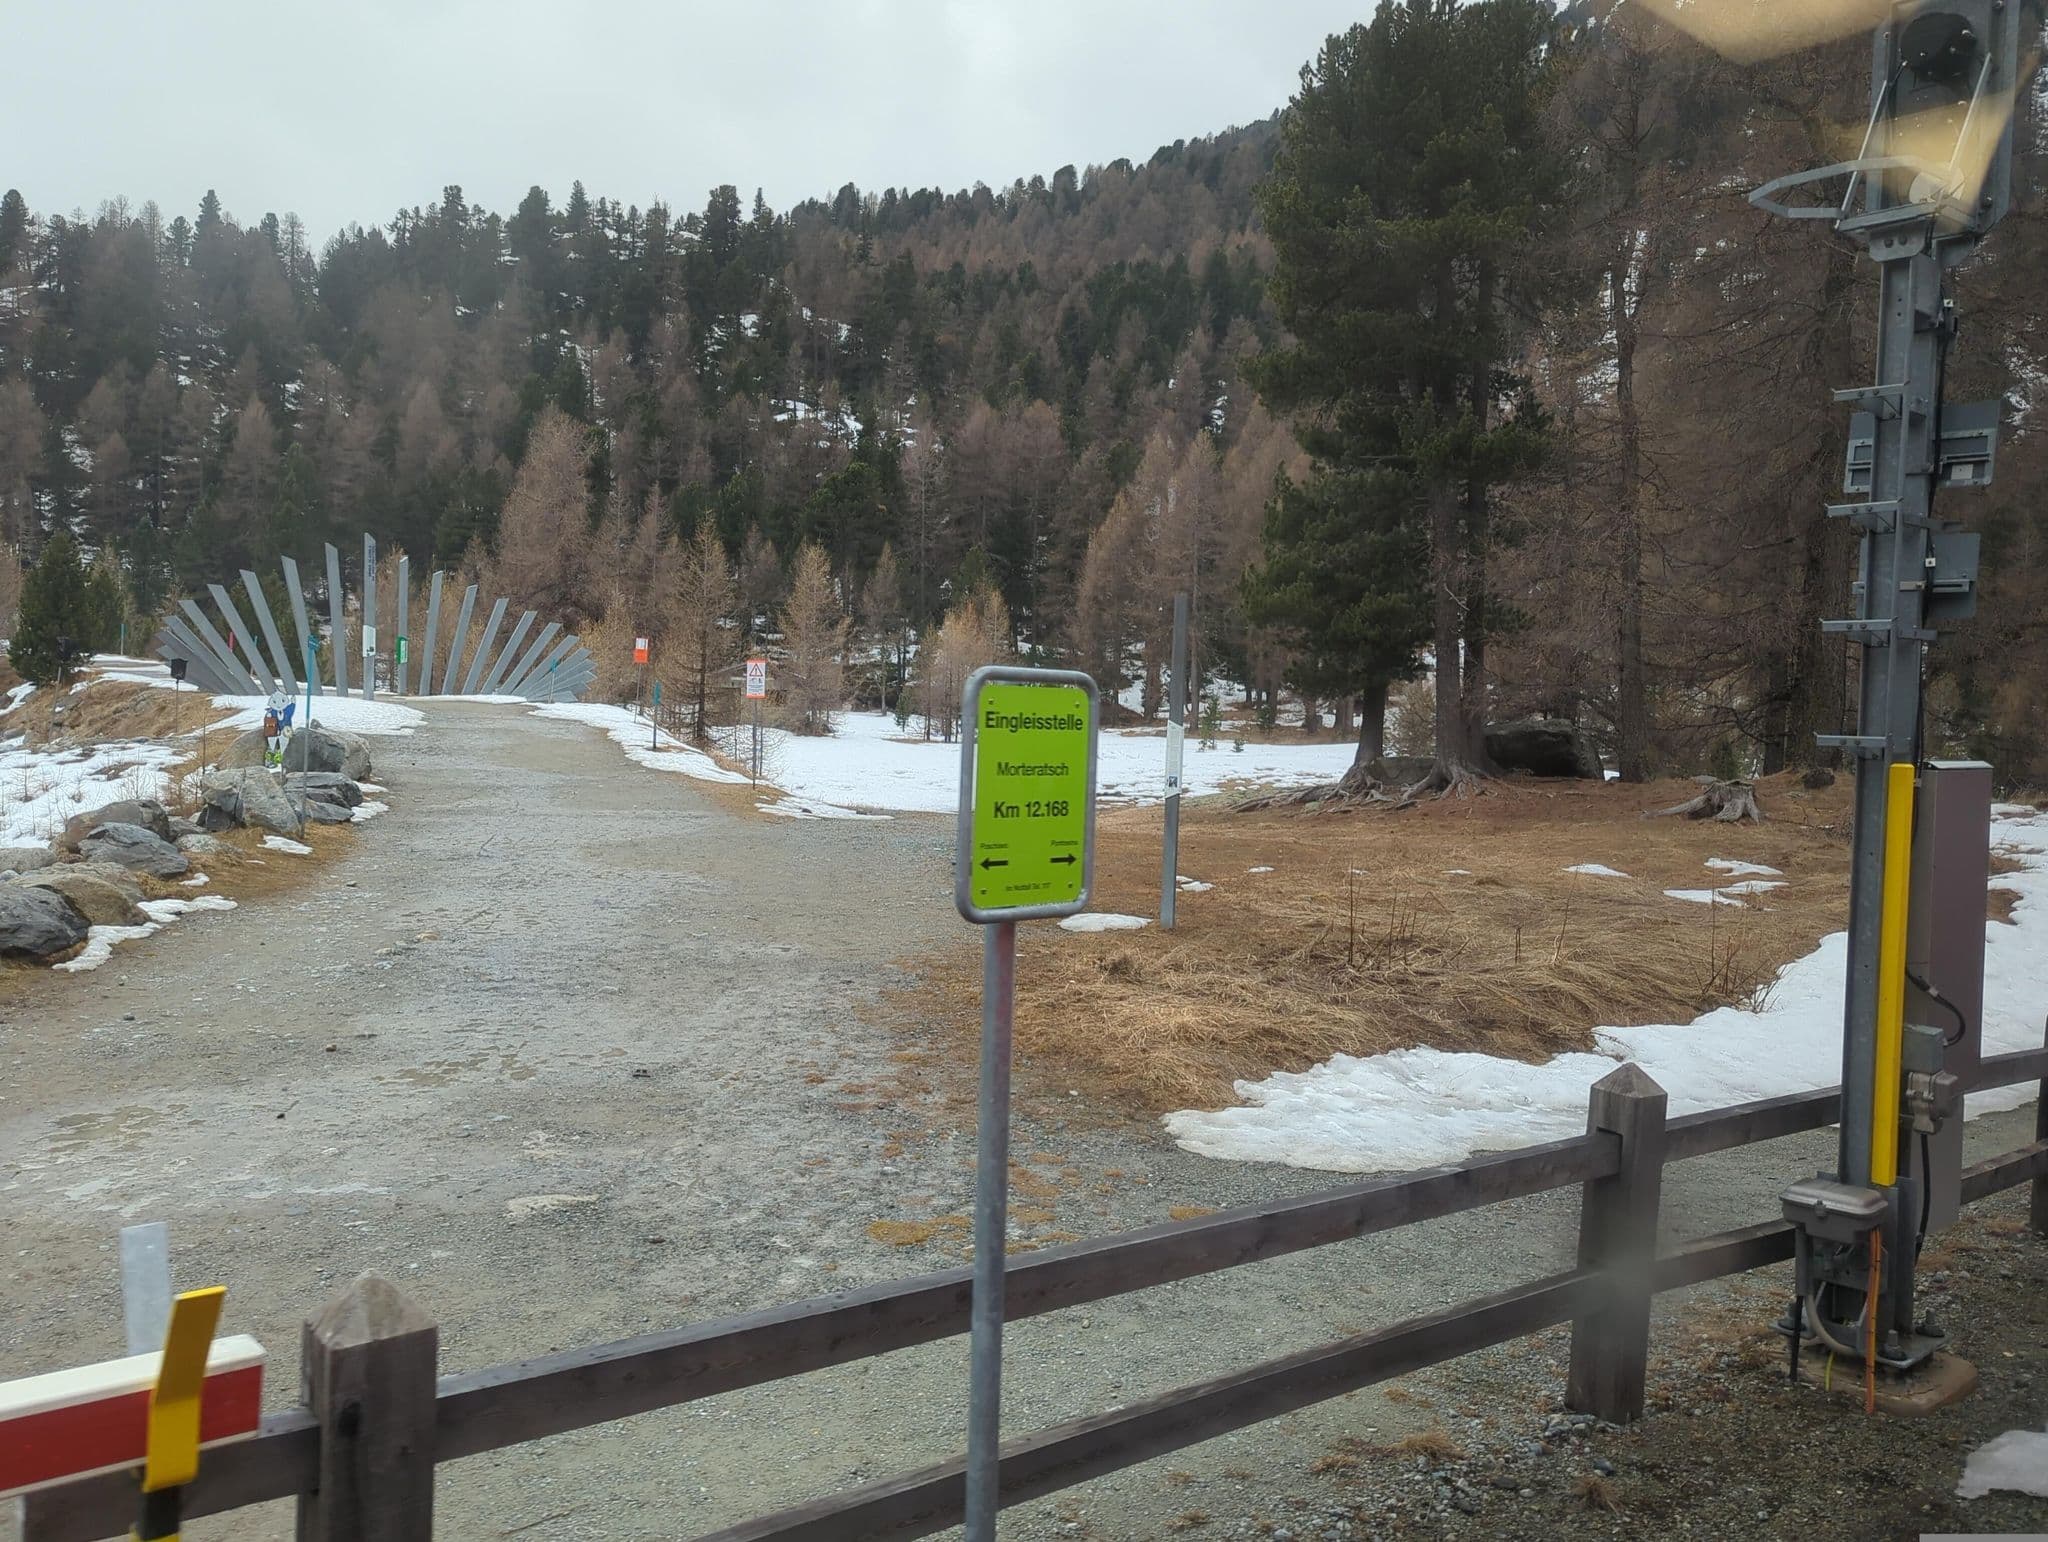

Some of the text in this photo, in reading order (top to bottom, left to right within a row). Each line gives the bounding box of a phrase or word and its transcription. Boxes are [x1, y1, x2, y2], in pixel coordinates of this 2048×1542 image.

[985, 711, 1083, 733] Eingleisstelle
[997, 761, 1069, 776] Morteratsch
[993, 800, 1069, 818] Km 12.168
